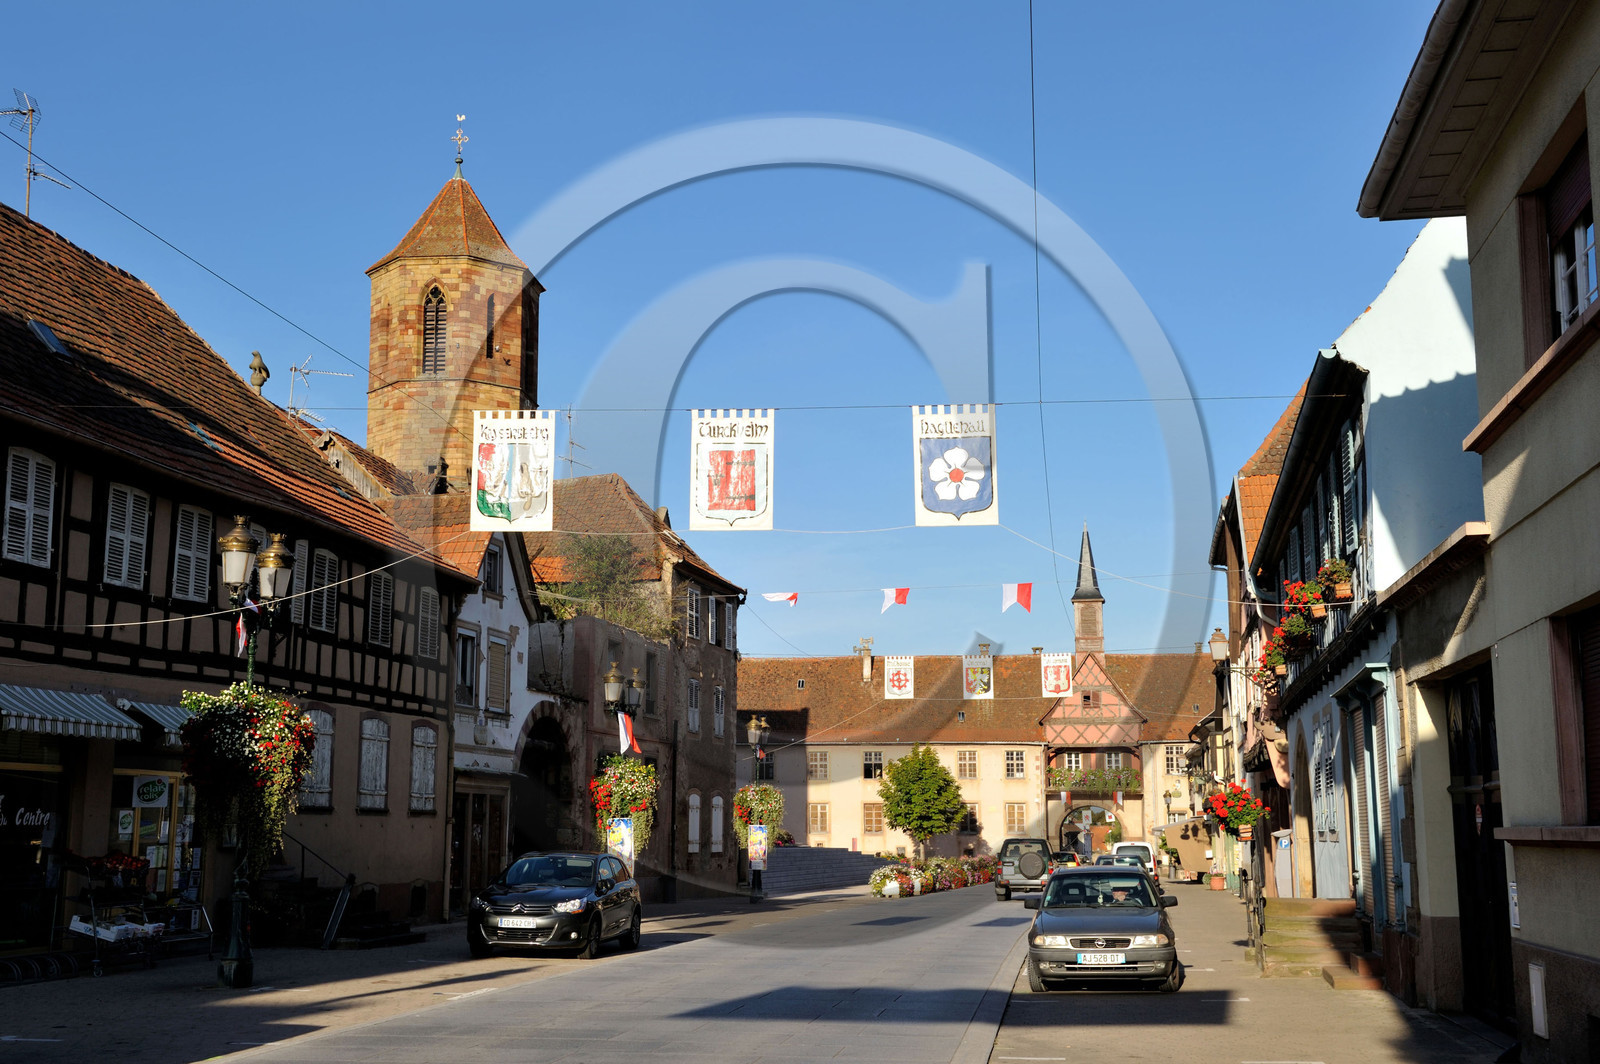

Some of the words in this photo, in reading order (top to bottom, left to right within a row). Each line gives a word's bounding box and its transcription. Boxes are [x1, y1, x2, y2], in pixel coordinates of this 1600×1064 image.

[140, 784, 167, 793] relais
[140, 792, 159, 801] colis
[15, 807, 51, 826] Centre
[1281, 839, 1289, 849] P
